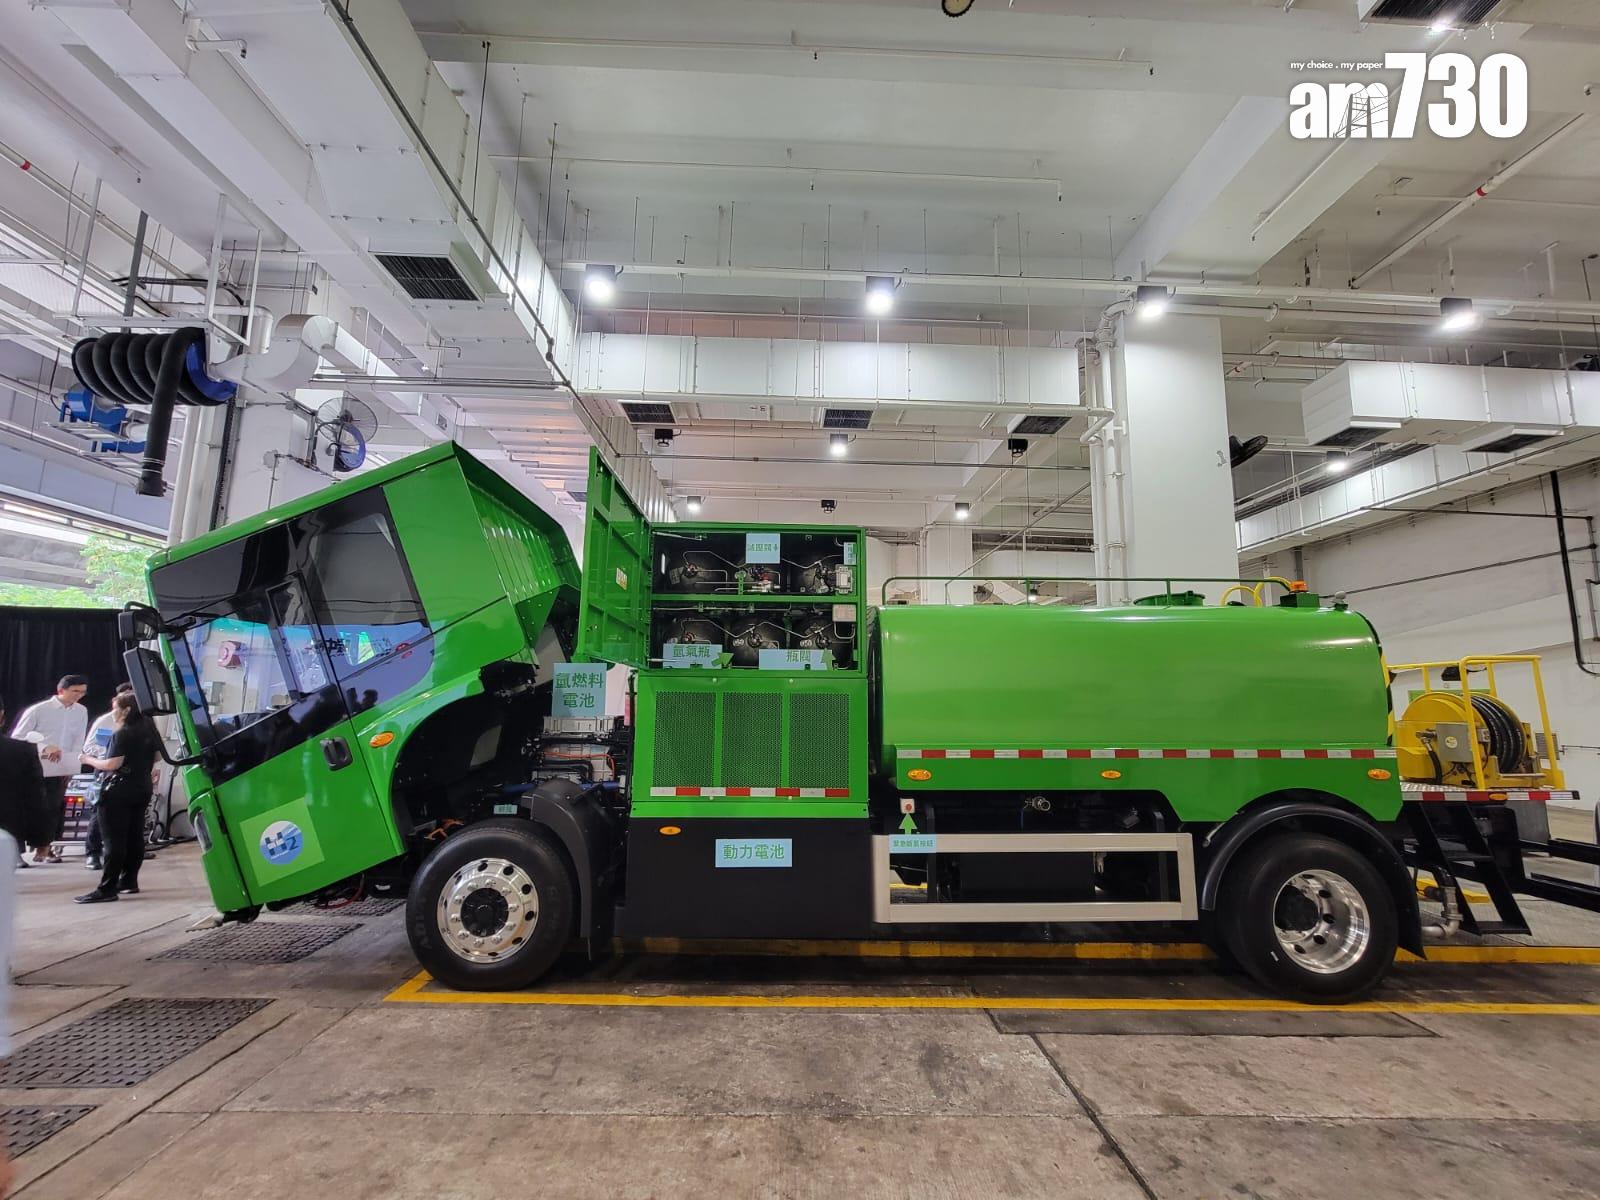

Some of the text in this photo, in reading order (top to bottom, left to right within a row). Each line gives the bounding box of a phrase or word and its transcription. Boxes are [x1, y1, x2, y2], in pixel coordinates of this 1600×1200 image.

[555, 672, 604, 689] 氫燃料
[562, 692, 595, 708] 電池
[723, 844, 785, 860] 動力電池
